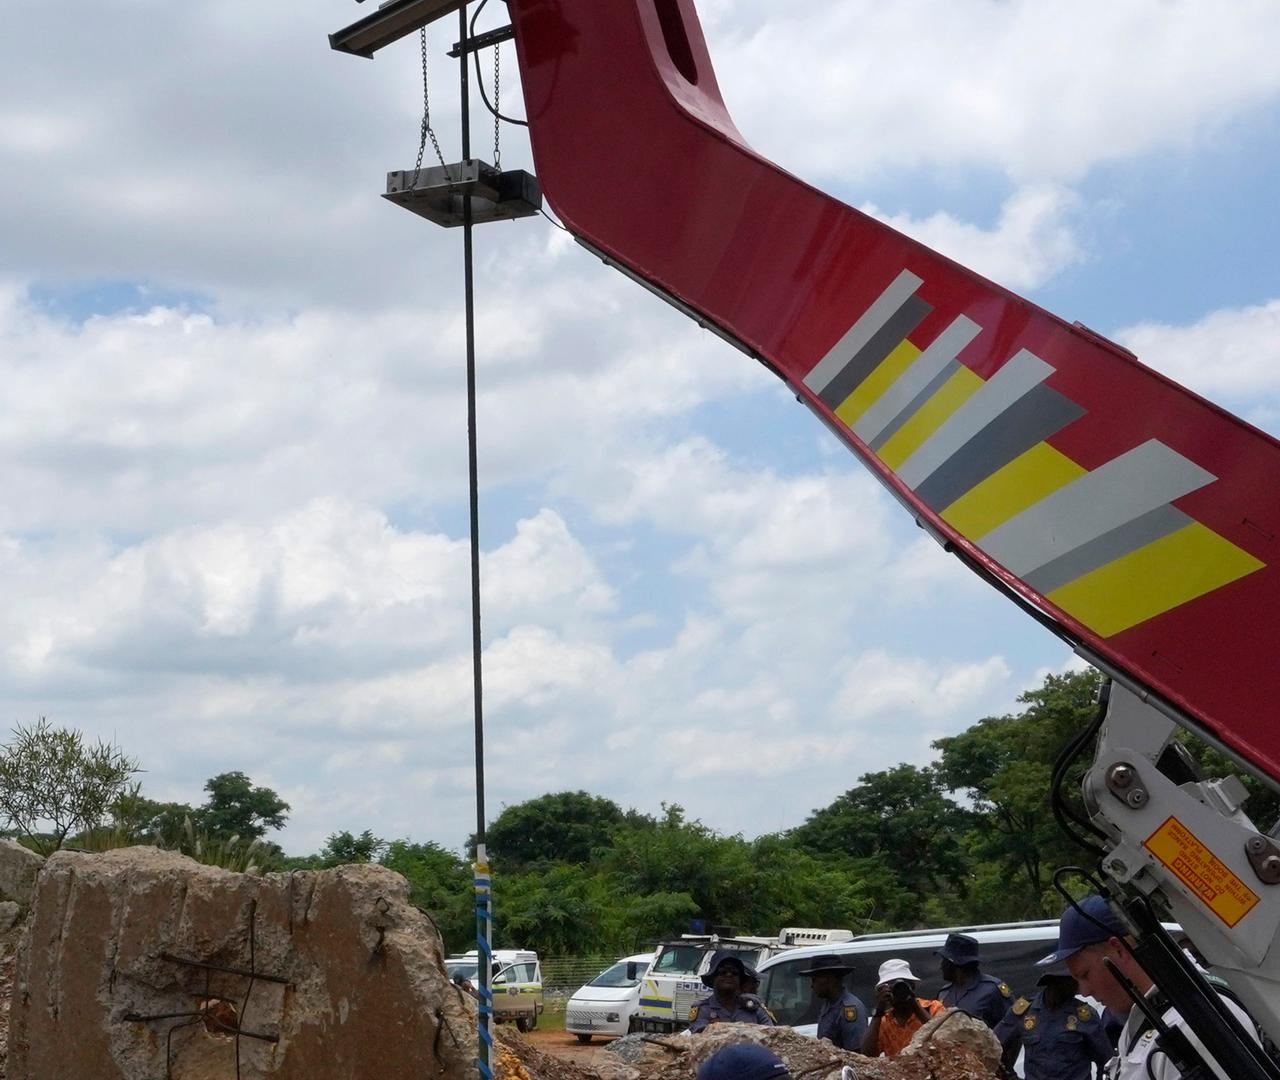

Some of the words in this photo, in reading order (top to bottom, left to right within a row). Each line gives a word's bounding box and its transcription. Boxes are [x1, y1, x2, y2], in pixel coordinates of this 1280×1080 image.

[1167, 830, 1189, 851] RANGE
[1171, 823, 1203, 854] PLATFORM
[1178, 850, 1199, 870] STAND
[1189, 851, 1224, 884] OPERATING
[1208, 858, 1228, 878] BOOM
[1174, 859, 1216, 899] WARNING
[1201, 871, 1214, 884] NOT
[1229, 878, 1242, 891] THE
[1215, 885, 1225, 895] DO
[1224, 884, 1247, 904] WITHIN
